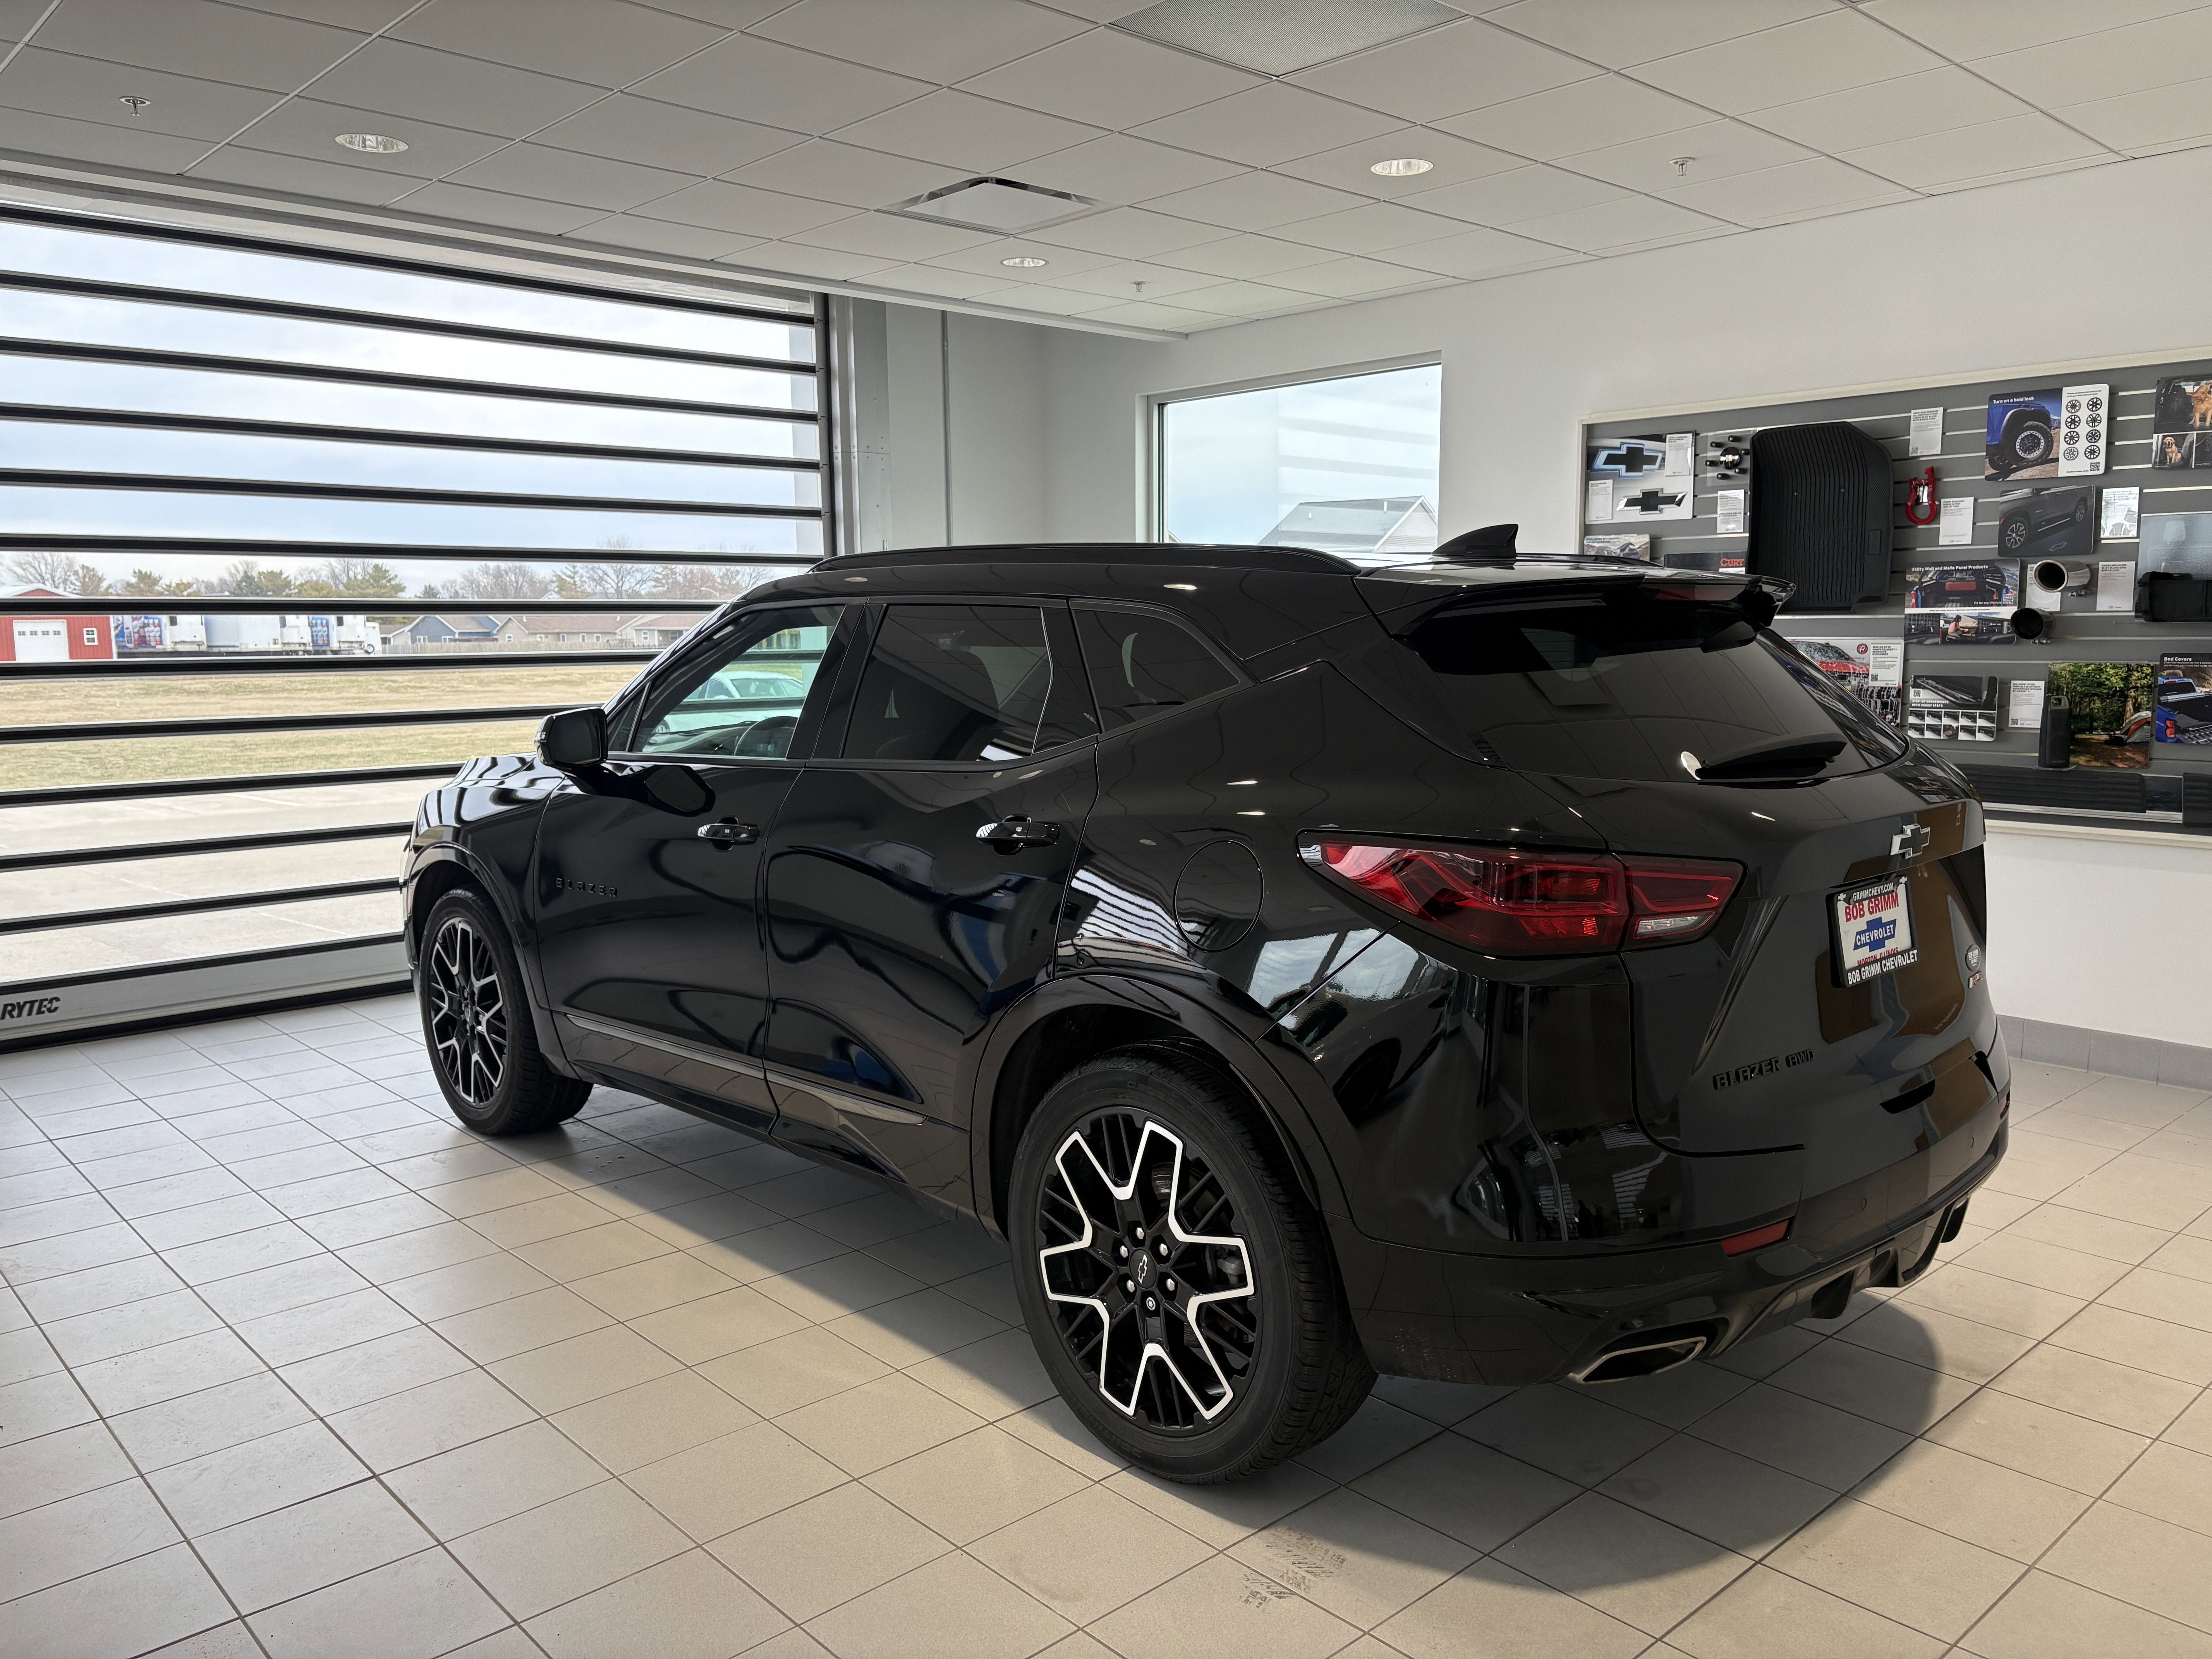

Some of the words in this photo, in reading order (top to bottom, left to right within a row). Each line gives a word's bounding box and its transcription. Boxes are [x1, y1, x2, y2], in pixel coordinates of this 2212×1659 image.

[556, 878, 619, 898] BLAZER
[1853, 882, 1894, 901] GRIMMCHEVY.COM
[1844, 902, 1865, 922] BOB
[1867, 891, 1899, 915] GRIMM
[1856, 924, 1894, 946] CHEVROLET
[1848, 969, 1860, 985] BOB
[1861, 962, 1881, 980] GRIMM
[1882, 950, 1918, 972] CHEVROLET
[0, 996, 60, 1020] RYTEC
[1712, 1056, 1781, 1091] BLAZER
